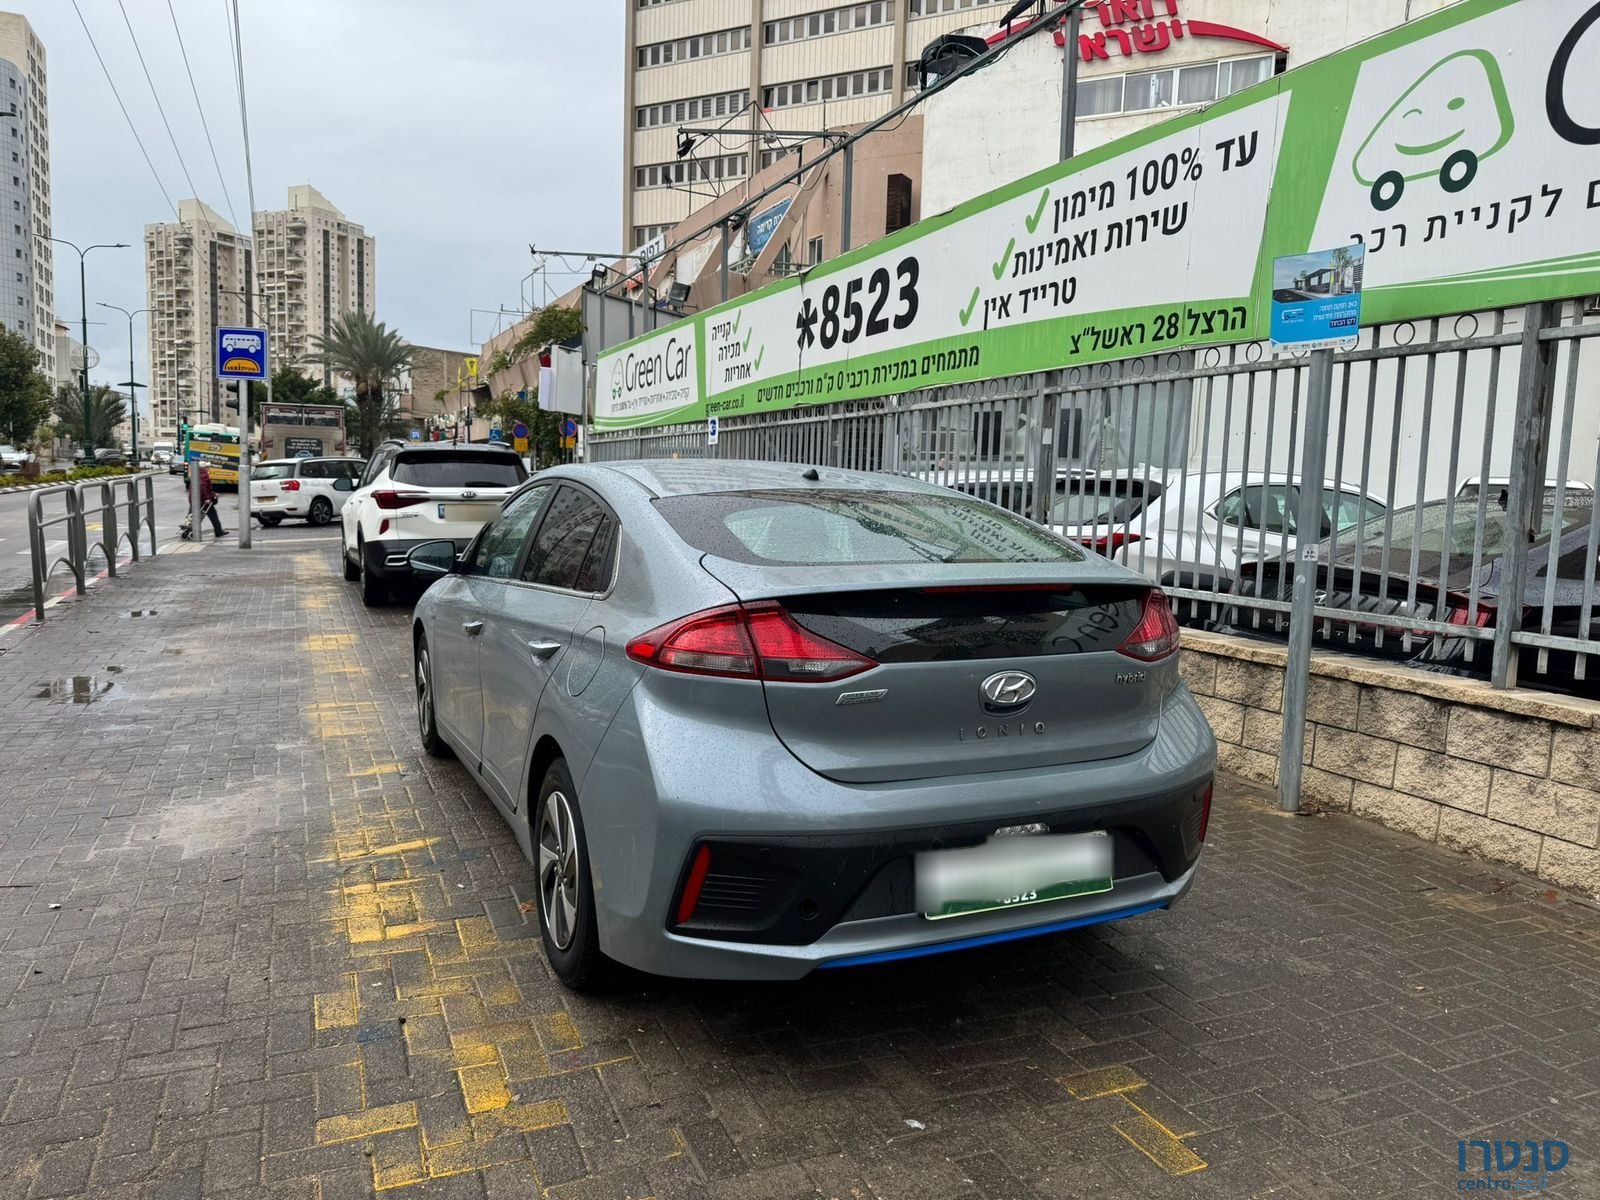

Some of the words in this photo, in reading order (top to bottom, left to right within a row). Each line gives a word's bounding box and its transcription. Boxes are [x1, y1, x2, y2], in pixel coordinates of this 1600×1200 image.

[1215, 130, 1258, 172] עד
[1126, 147, 1203, 201] 100%
[1053, 180, 1116, 234] מימון
[1423, 184, 1563, 243] לקניית
[1104, 201, 1188, 253] שירות
[1012, 228, 1098, 279] ואמינות
[1018, 276, 1077, 314] טרייד
[983, 292, 1012, 331] אין
[1151, 312, 1180, 342] 28
[1186, 305, 1248, 337] הרצל
[711, 321, 731, 342] קנייה
[625, 352, 662, 392] Green
[665, 337, 692, 382] Car
[718, 341, 741, 362] מכירה
[921, 344, 980, 375] מתמחים
[724, 362, 752, 384] אחריות
[836, 370, 844, 388] 0
[846, 368, 869, 390] רכבי
[872, 358, 918, 386] במכירת
[705, 393, 745, 418] green-car.co.il
[756, 386, 784, 403] חדשים
[1114, 671, 1147, 688] hybrid
